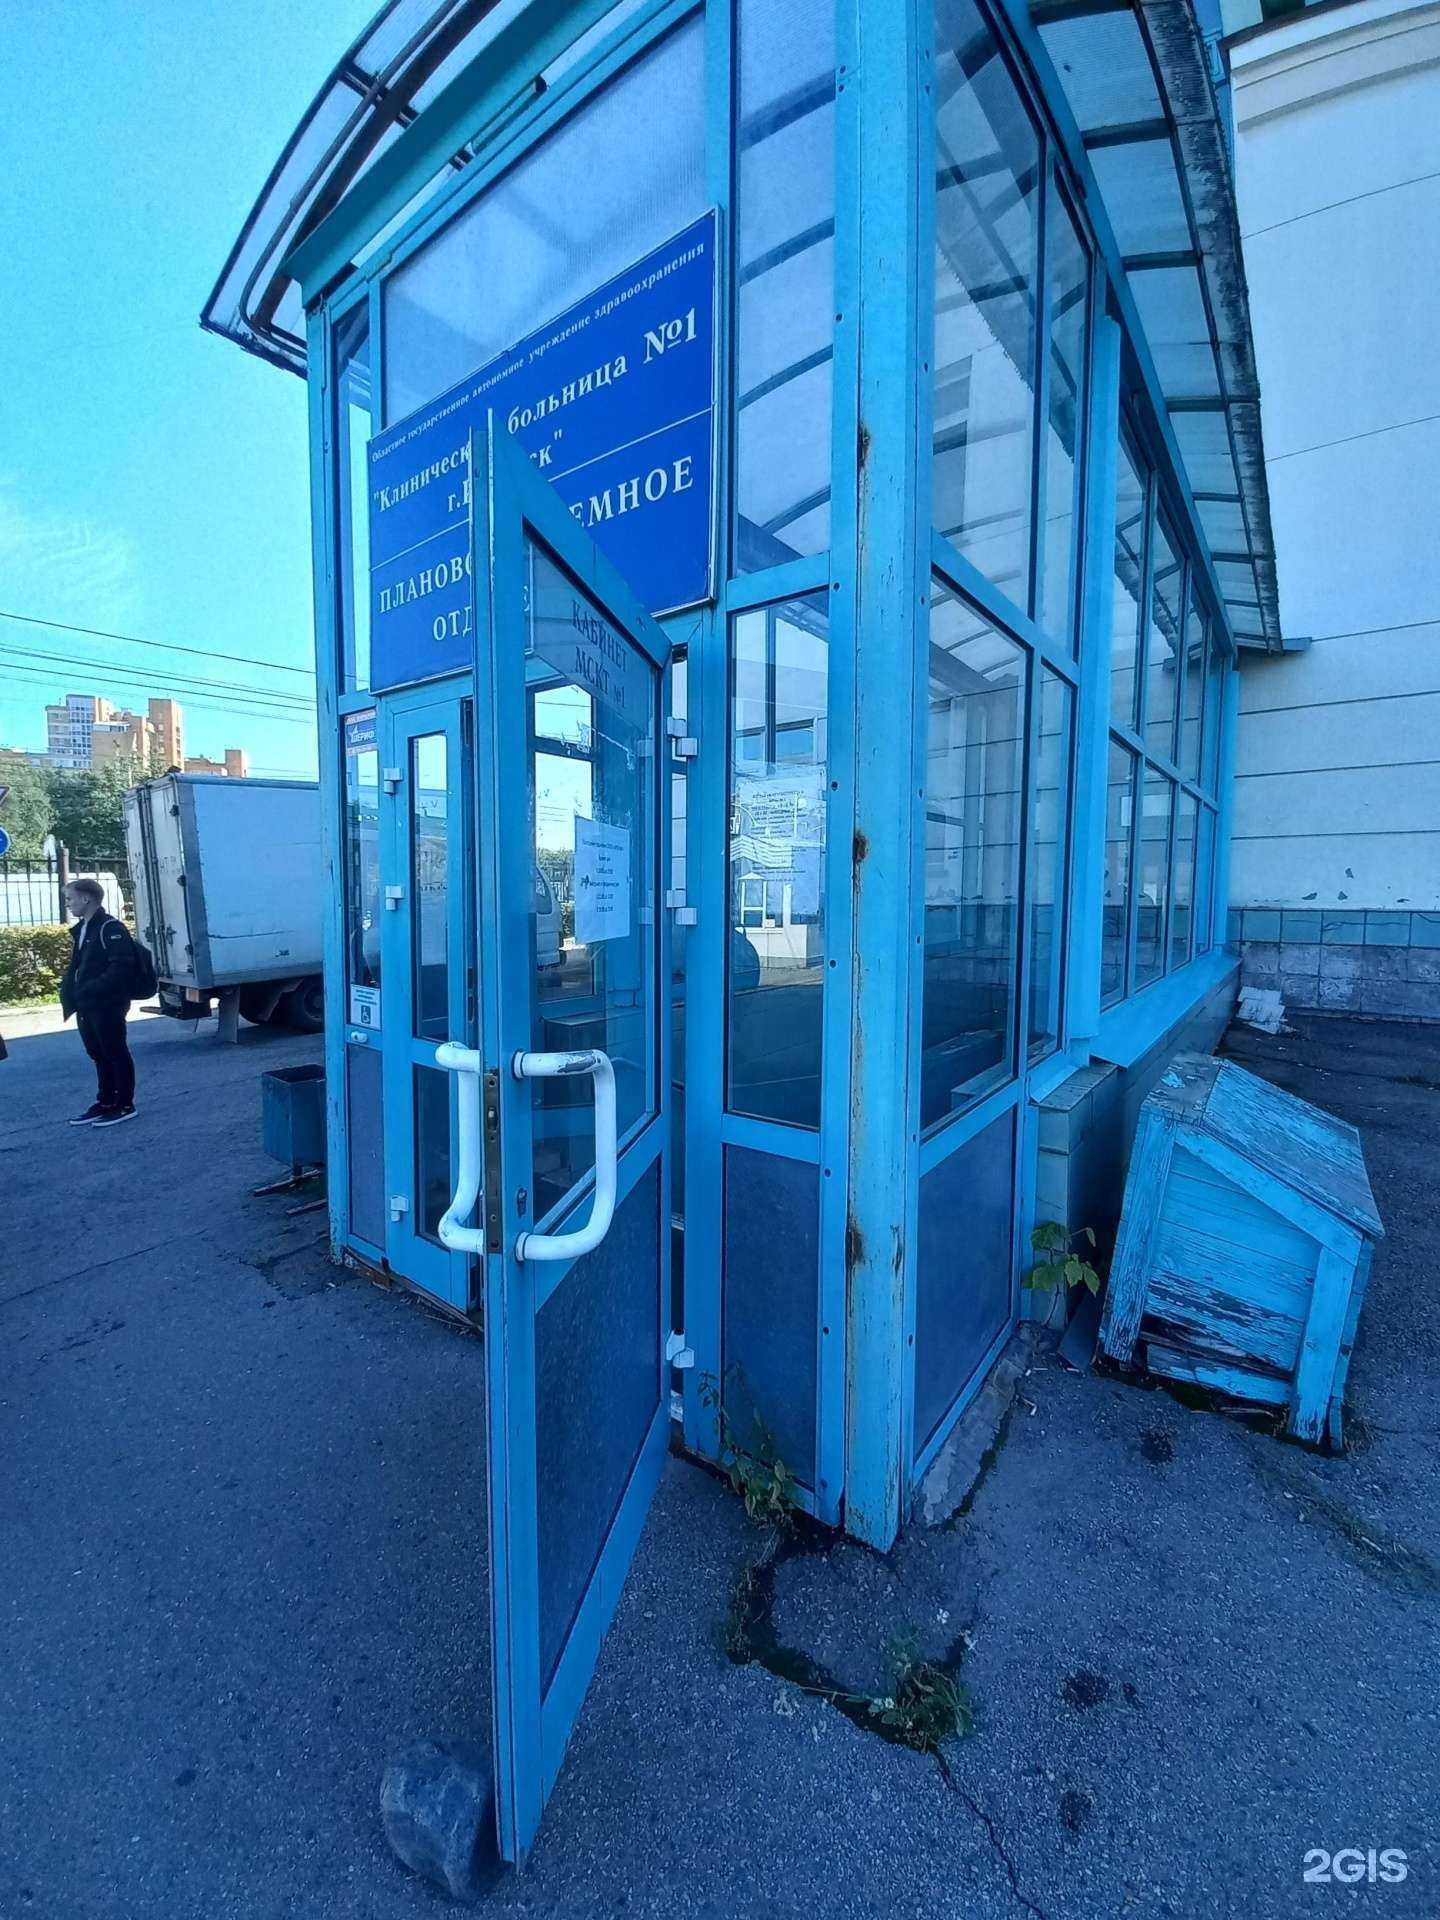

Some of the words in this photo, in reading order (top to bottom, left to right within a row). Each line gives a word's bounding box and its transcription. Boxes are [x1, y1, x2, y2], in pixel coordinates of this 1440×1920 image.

[372, 435, 407, 463] Областное
[407, 394, 470, 441] государственное
[472, 358, 524, 398] автономное
[528, 316, 591, 364] учреждение
[594, 242, 704, 320] здравоохранения
[373, 440, 472, 513] "Клиническ
[507, 355, 628, 435] больница
[643, 307, 698, 364] №1
[572, 599, 628, 673] КАБИНЕТ
[575, 645, 609, 695] МСКТ
